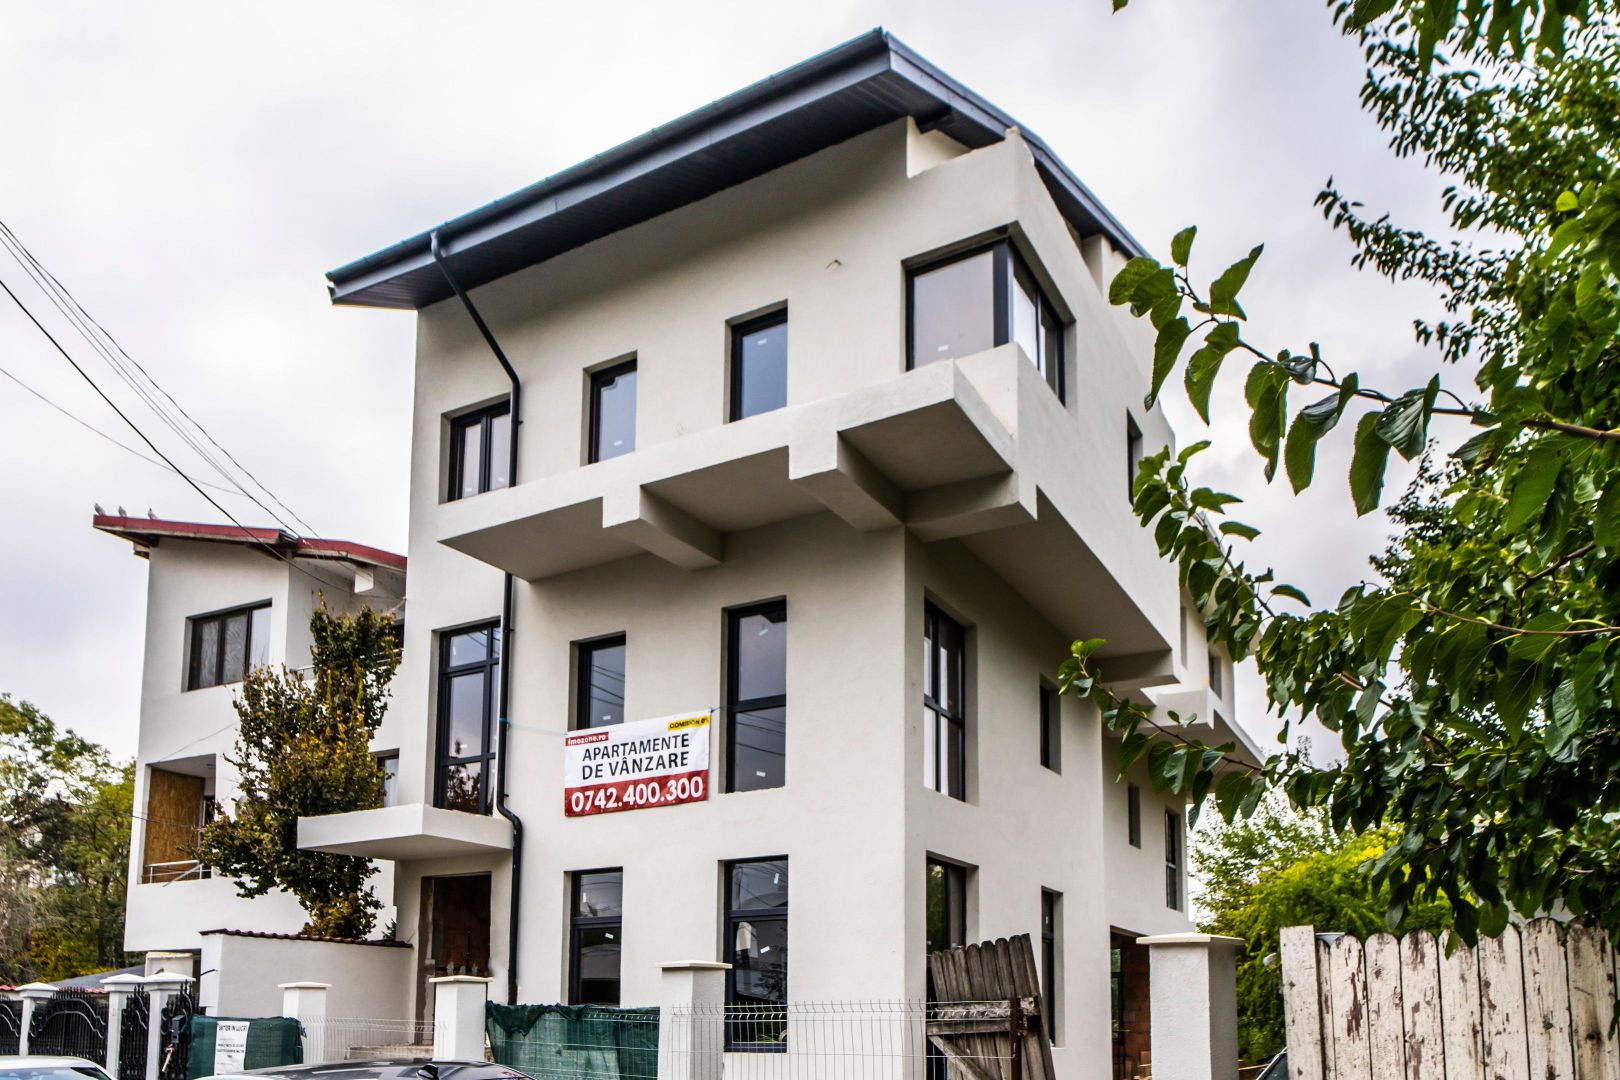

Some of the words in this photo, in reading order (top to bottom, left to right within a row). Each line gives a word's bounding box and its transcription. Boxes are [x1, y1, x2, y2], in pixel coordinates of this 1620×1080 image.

[669, 719, 700, 729] COMISION
[567, 734, 607, 745] imozone.ro
[582, 733, 690, 762] APARTAMENTE
[582, 763, 604, 780] DE
[608, 751, 689, 777] VÂNZARE
[571, 776, 704, 812] 0742.400.300
